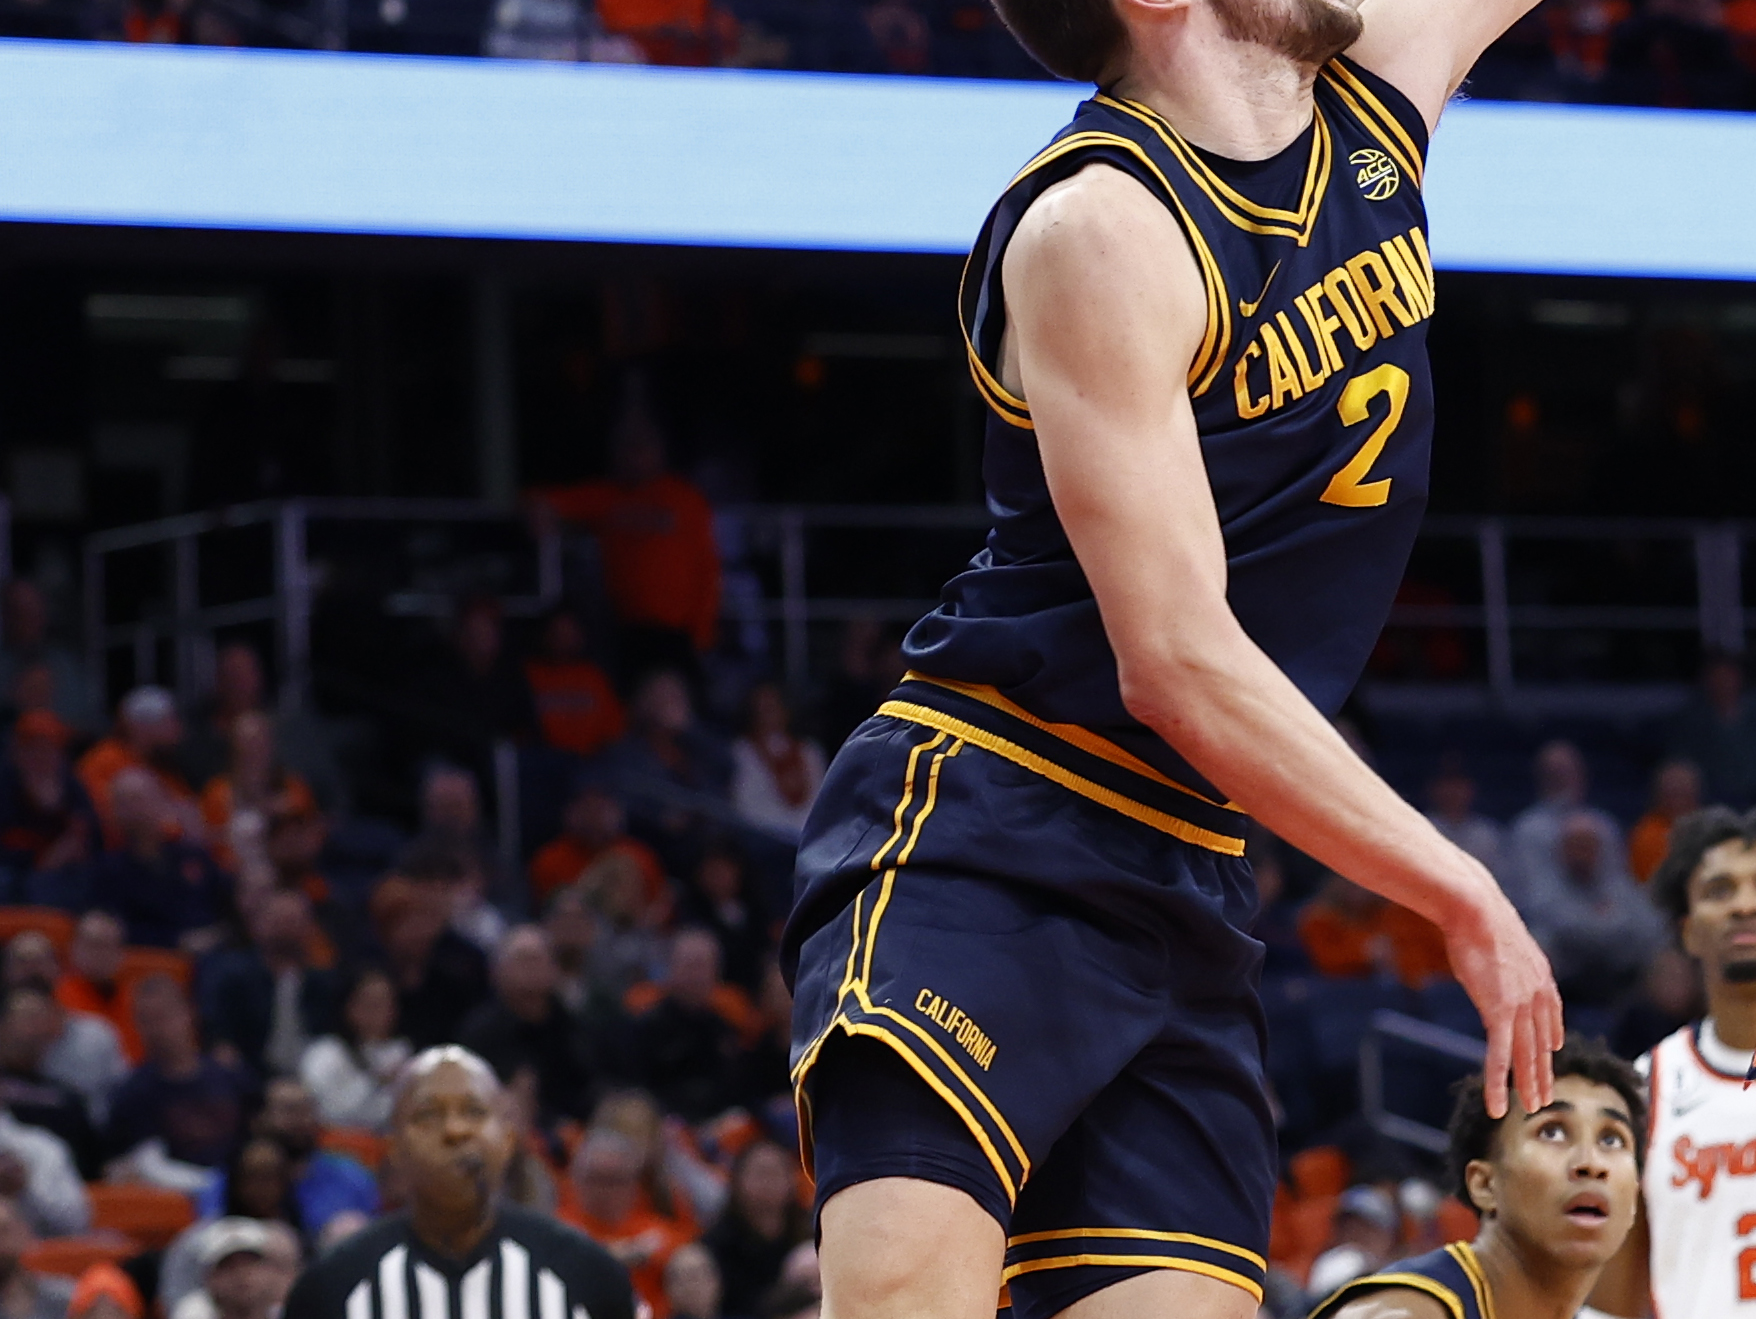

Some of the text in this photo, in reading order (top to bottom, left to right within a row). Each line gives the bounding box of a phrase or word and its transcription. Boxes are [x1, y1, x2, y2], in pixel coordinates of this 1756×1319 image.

[1357, 156, 1392, 184] ACC
[1319, 363, 1410, 508] 2
[914, 988, 998, 1072] CALIFORNIA
